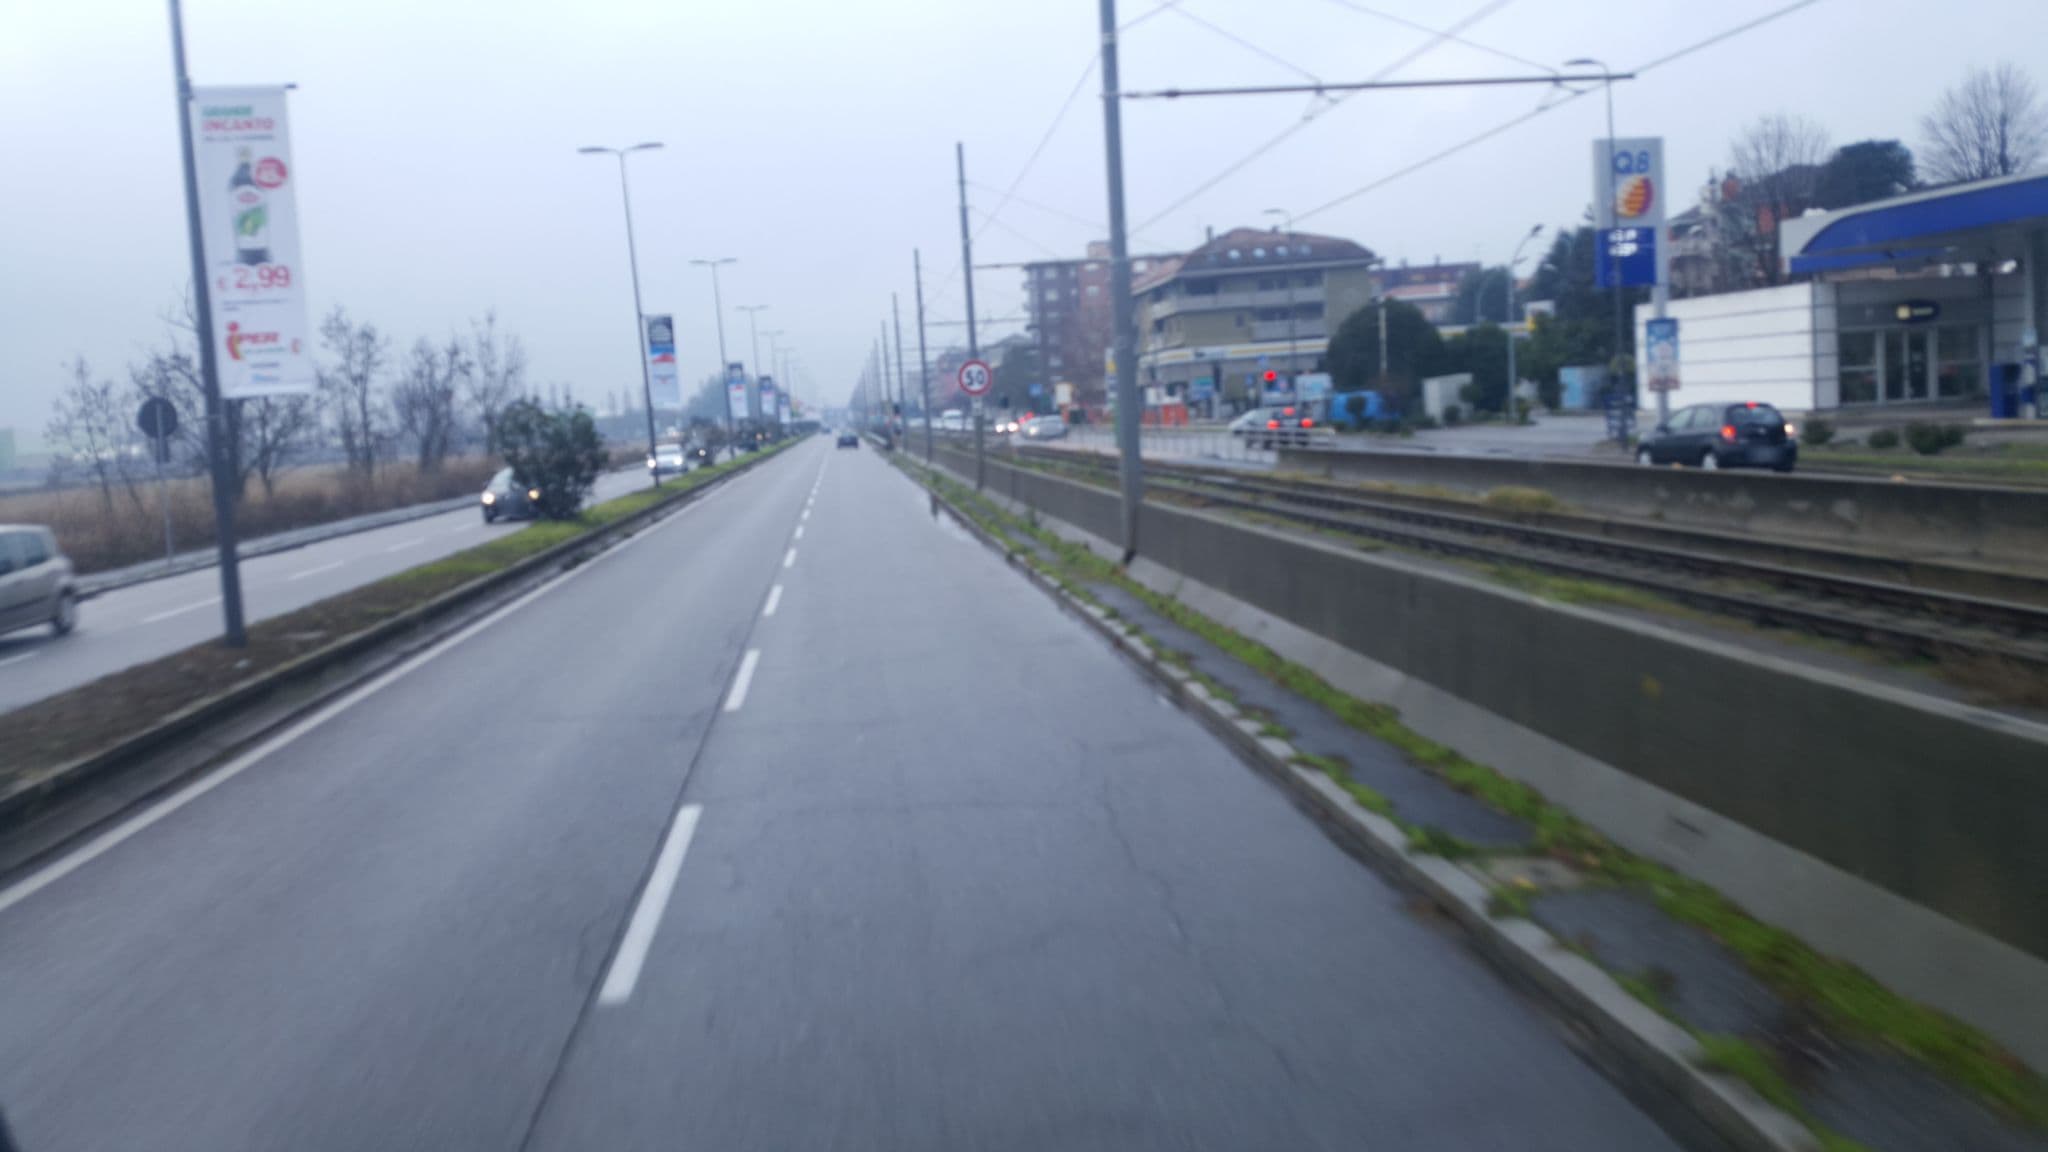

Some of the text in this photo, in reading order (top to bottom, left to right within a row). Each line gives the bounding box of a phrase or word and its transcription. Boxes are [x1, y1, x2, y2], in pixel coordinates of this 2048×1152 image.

[1613, 150, 1650, 174] Q8
[232, 263, 291, 295] 2,99
[966, 369, 985, 386] 50
